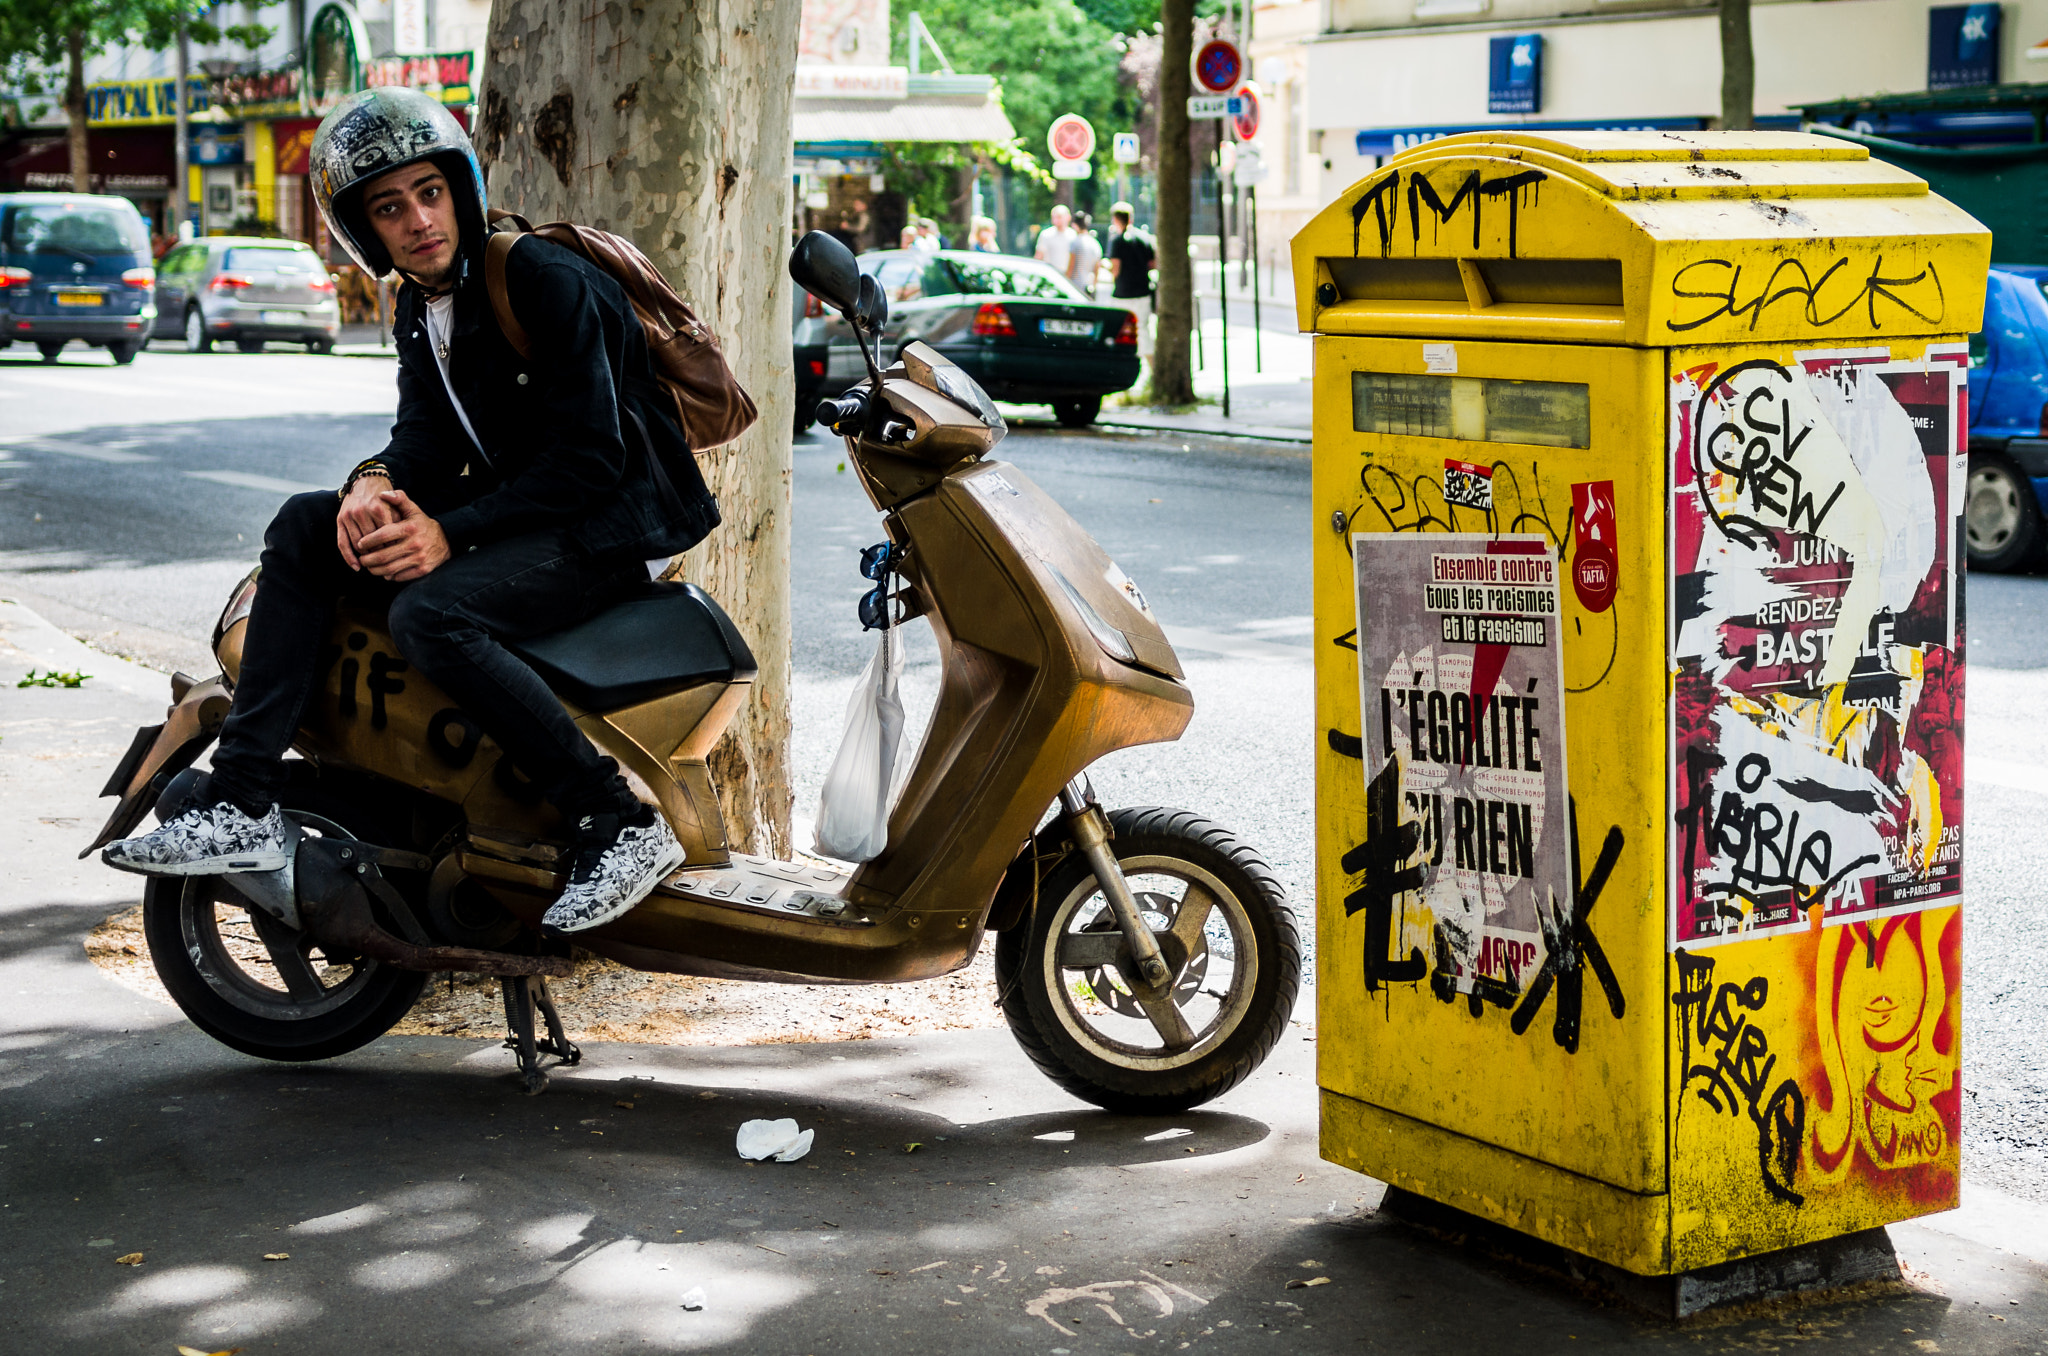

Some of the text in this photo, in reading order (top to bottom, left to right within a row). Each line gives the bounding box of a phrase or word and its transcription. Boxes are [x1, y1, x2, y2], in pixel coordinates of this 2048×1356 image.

[1194, 101, 1225, 112] SAUF
[1433, 555, 1553, 583] Ensemble contre
[1582, 569, 1605, 584] TAFTA
[1427, 585, 1555, 613] tous les racismes
[1443, 616, 1460, 641] et
[1478, 620, 1545, 645] fascisme
[1381, 671, 1541, 772] L'ÉGALITÉ
[1456, 797, 1534, 879] RIEN
[1893, 882, 1942, 900] NPA-PARIS.ORG
